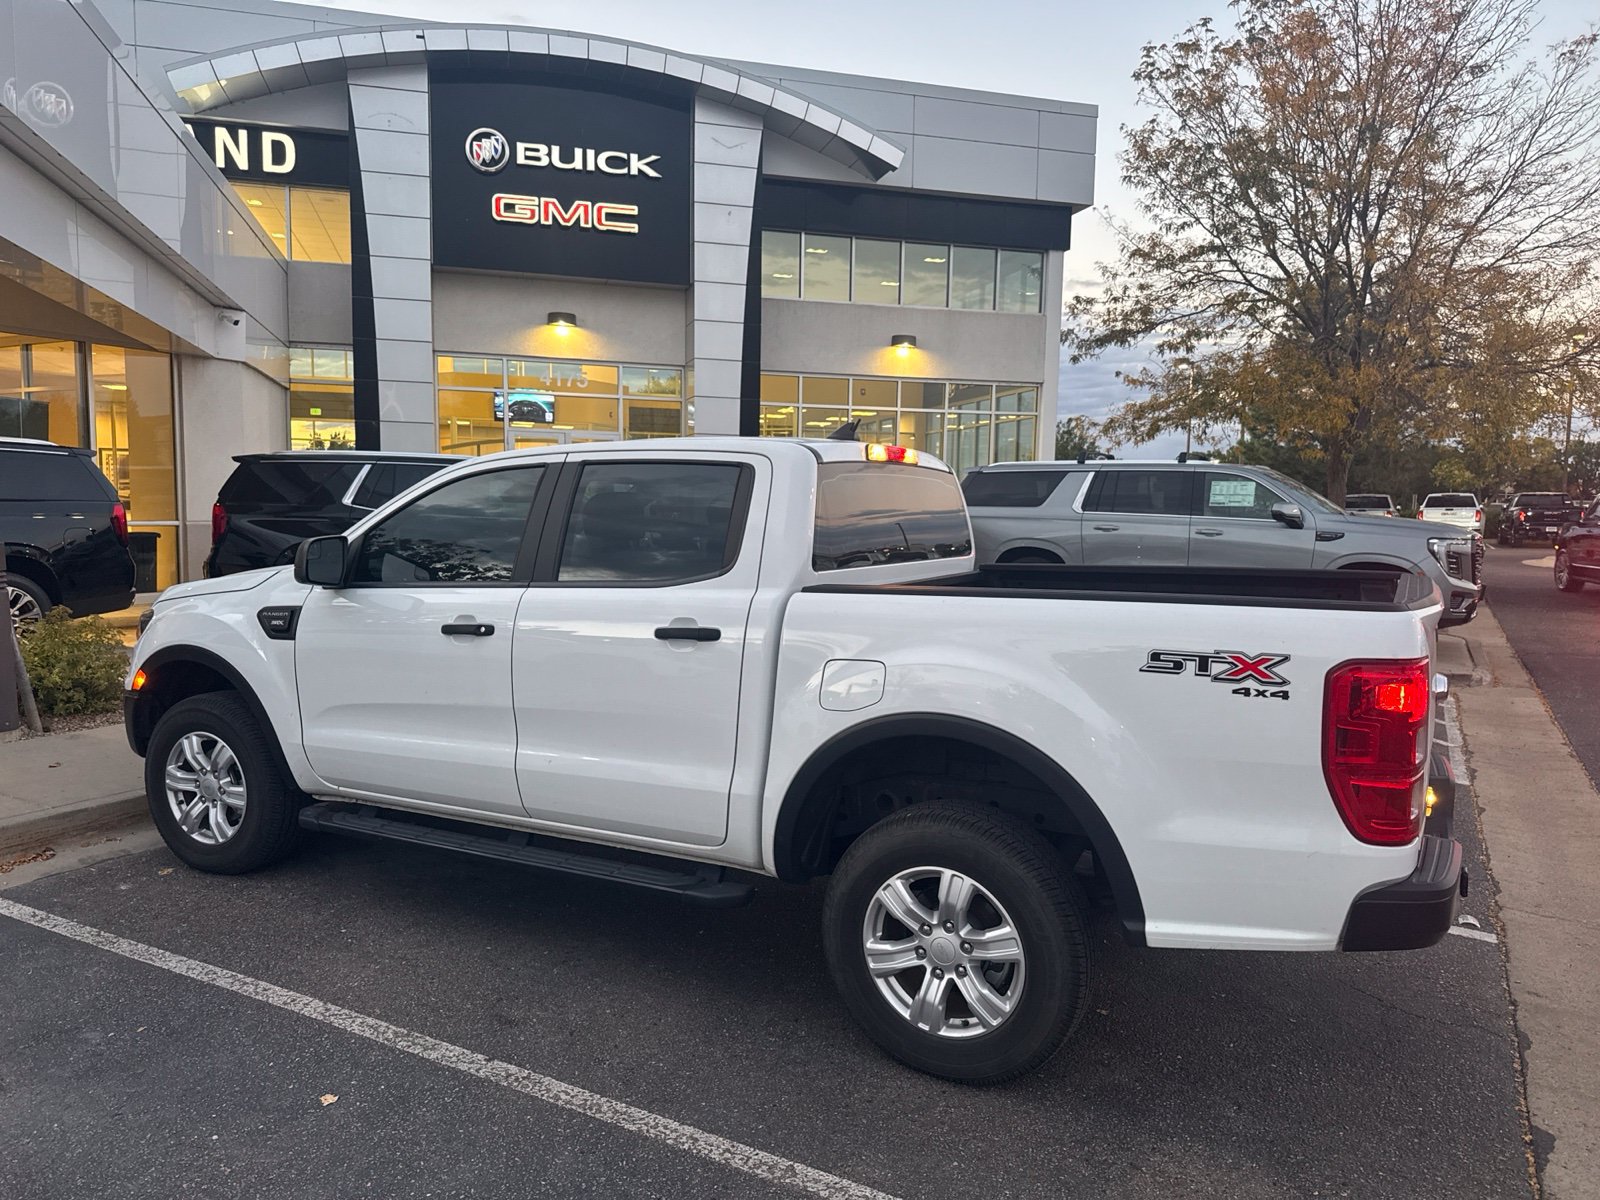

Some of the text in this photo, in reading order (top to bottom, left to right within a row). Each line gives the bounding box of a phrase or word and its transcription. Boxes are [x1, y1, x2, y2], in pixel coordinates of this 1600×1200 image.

[185, 123, 296, 174] ND
[516, 141, 662, 178] BUICK
[491, 193, 639, 234] GMC
[540, 369, 588, 388] 4175
[1139, 649, 1291, 687] STX
